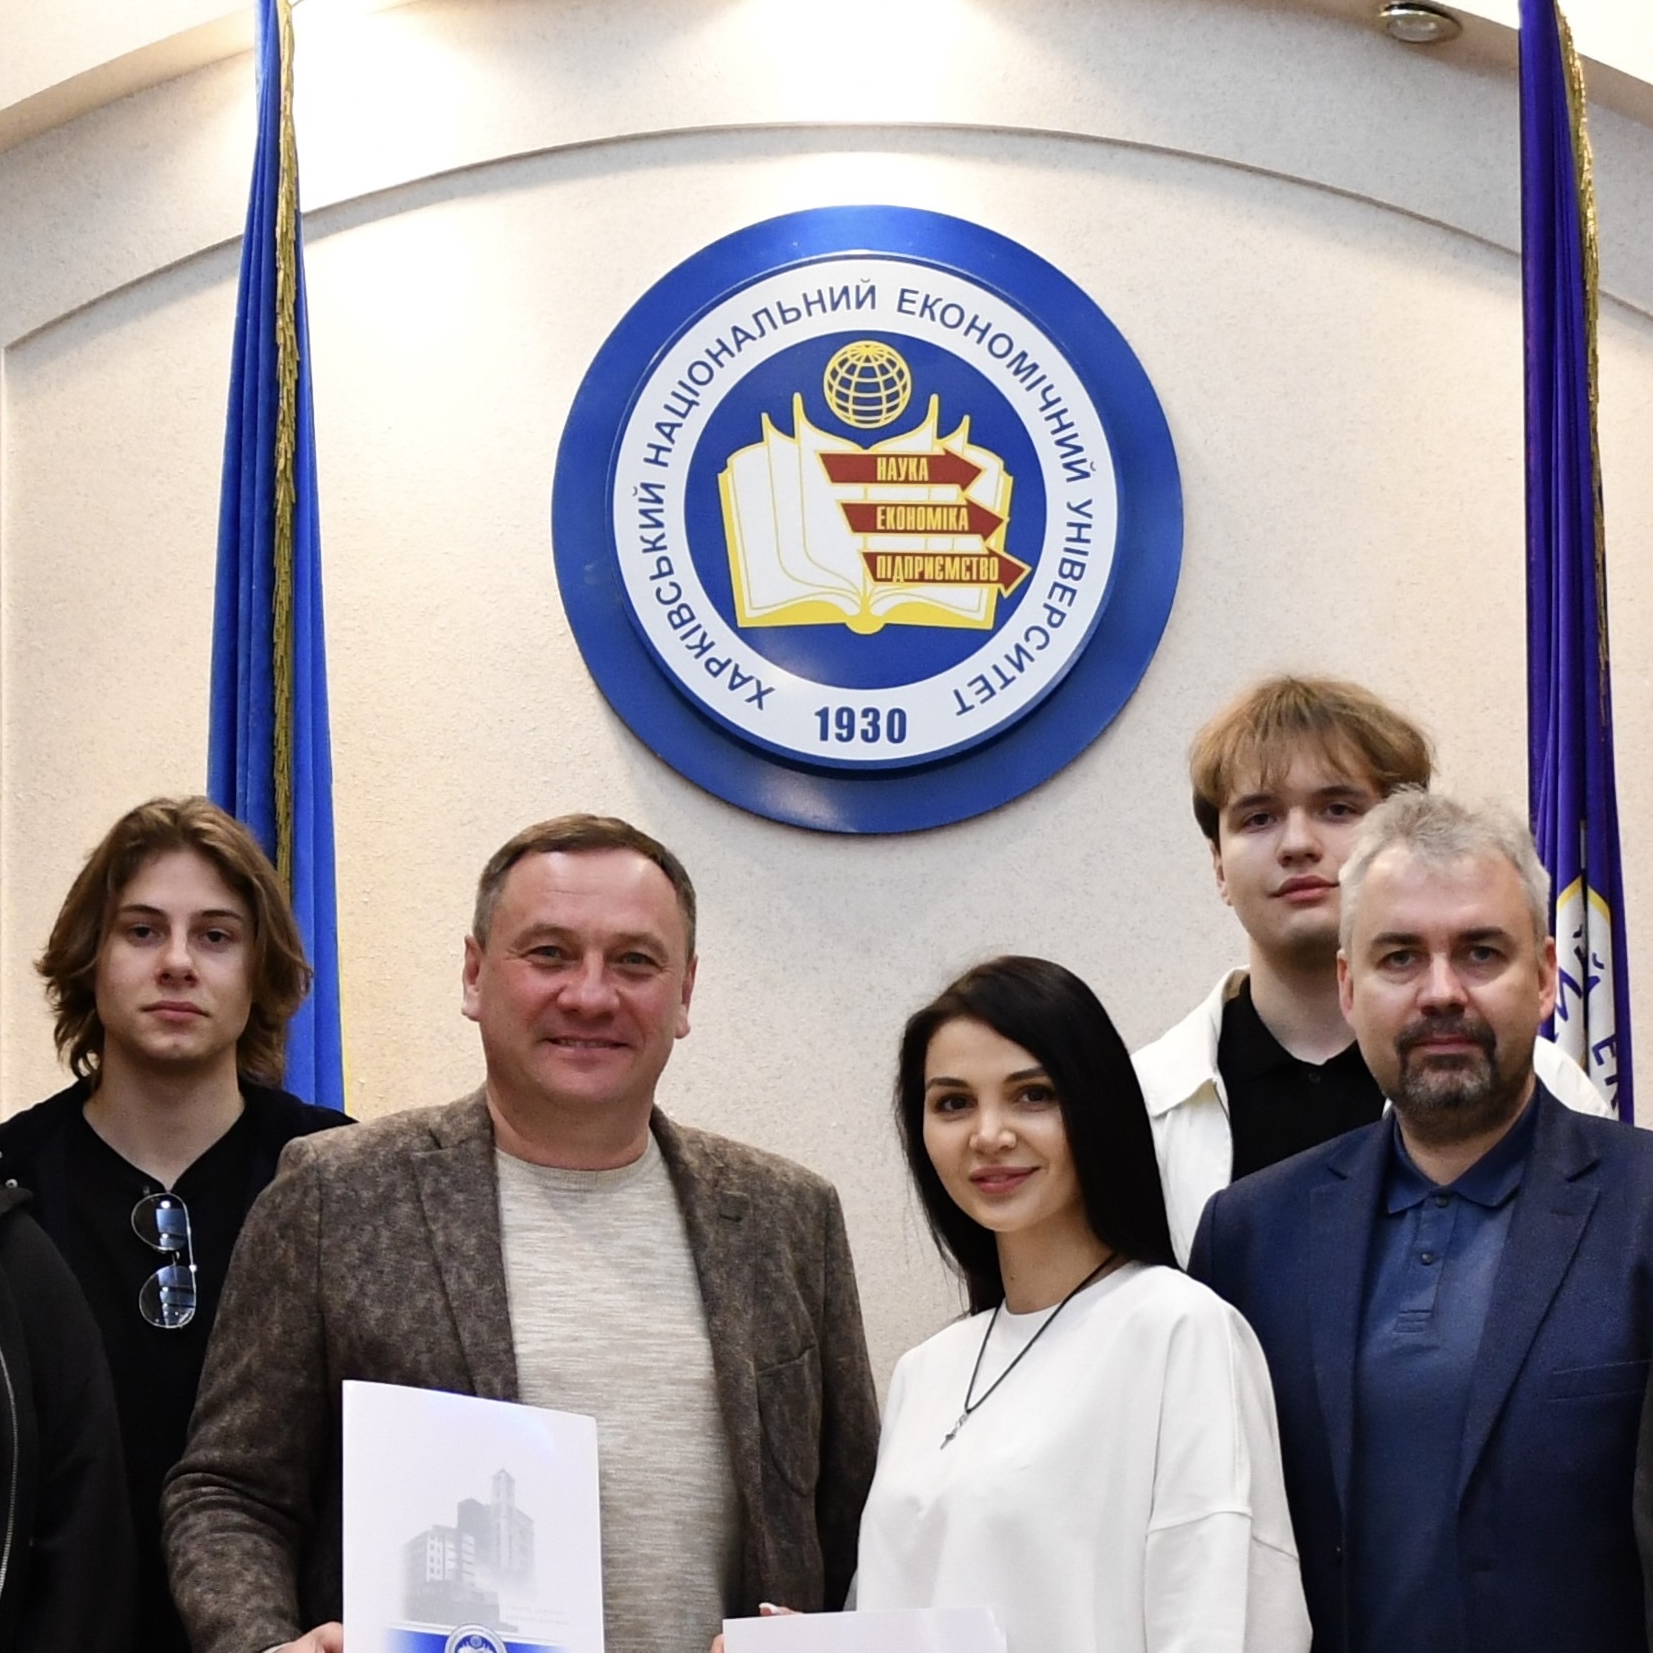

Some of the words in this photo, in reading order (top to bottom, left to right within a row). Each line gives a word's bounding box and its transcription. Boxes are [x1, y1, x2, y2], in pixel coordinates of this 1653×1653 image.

[642, 278, 878, 466] НАЦІОНАЛЬНИЙ
[896, 287, 1097, 484] ЕКОНОМІЧНИЙ
[876, 457, 930, 482] НАУКА
[876, 505, 969, 531] ЕКОНОМІКА
[632, 482, 776, 711] ХАРКІВСЬКИЙ
[876, 555, 999, 583] ПІДПРИЄМСТВО
[952, 498, 1094, 717] УНІВЕРСИТЕТ
[813, 705, 908, 745] 1930
